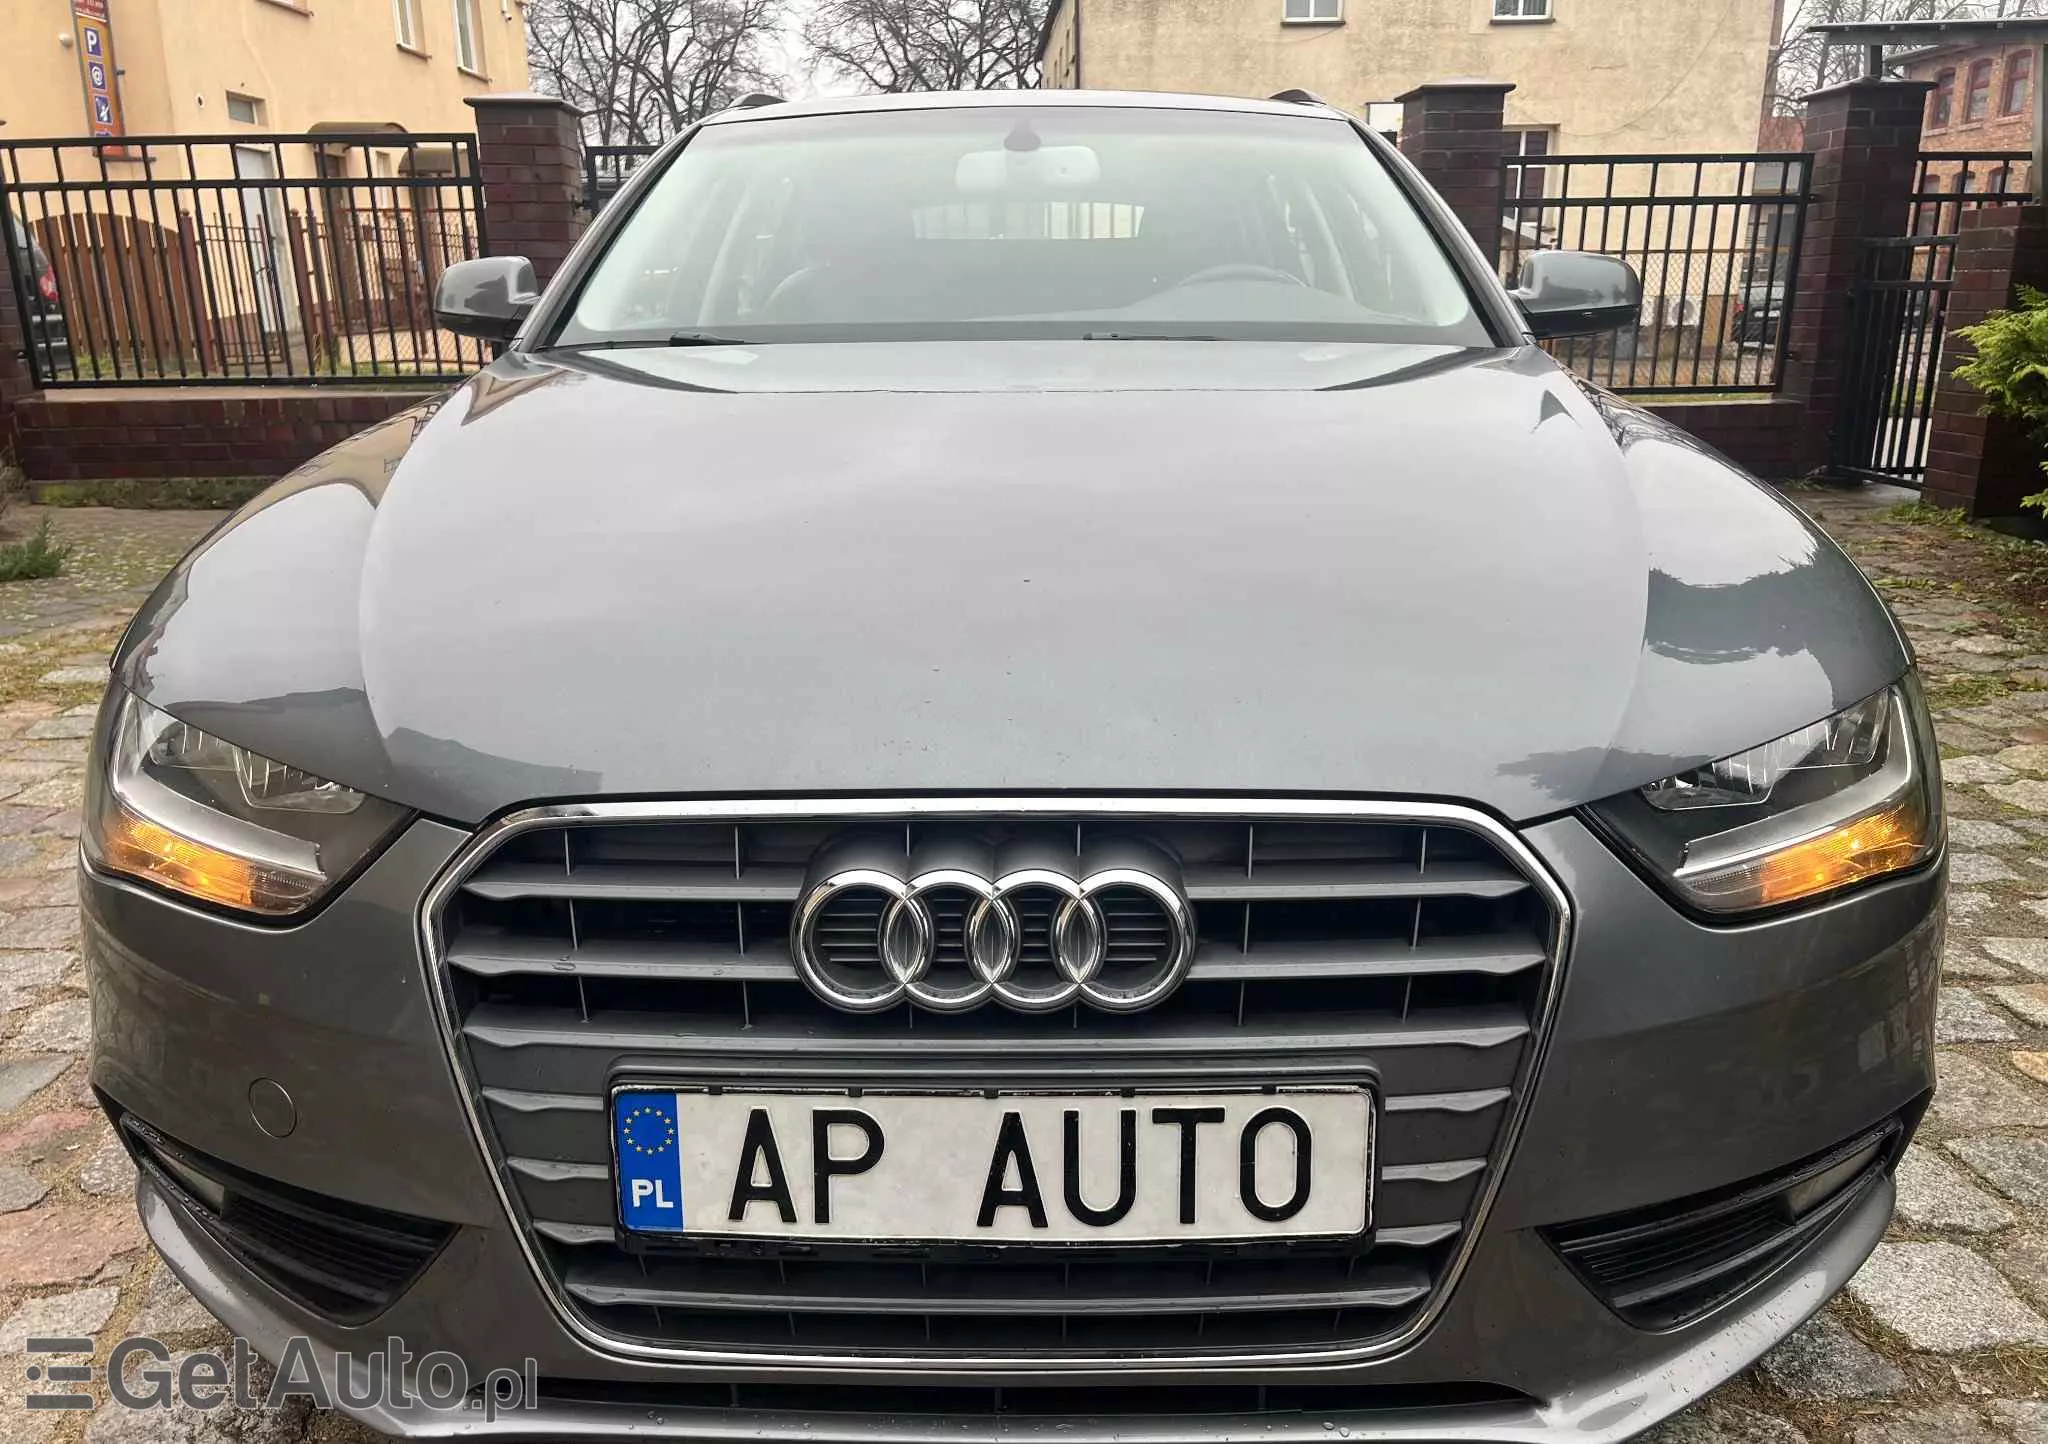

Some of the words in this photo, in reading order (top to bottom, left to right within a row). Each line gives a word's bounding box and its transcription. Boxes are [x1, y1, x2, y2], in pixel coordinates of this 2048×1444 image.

[86, 31, 98, 53] P
[727, 1106, 885, 1224] AP
[976, 1106, 1312, 1229] AUTO
[630, 1178, 674, 1209] PL
